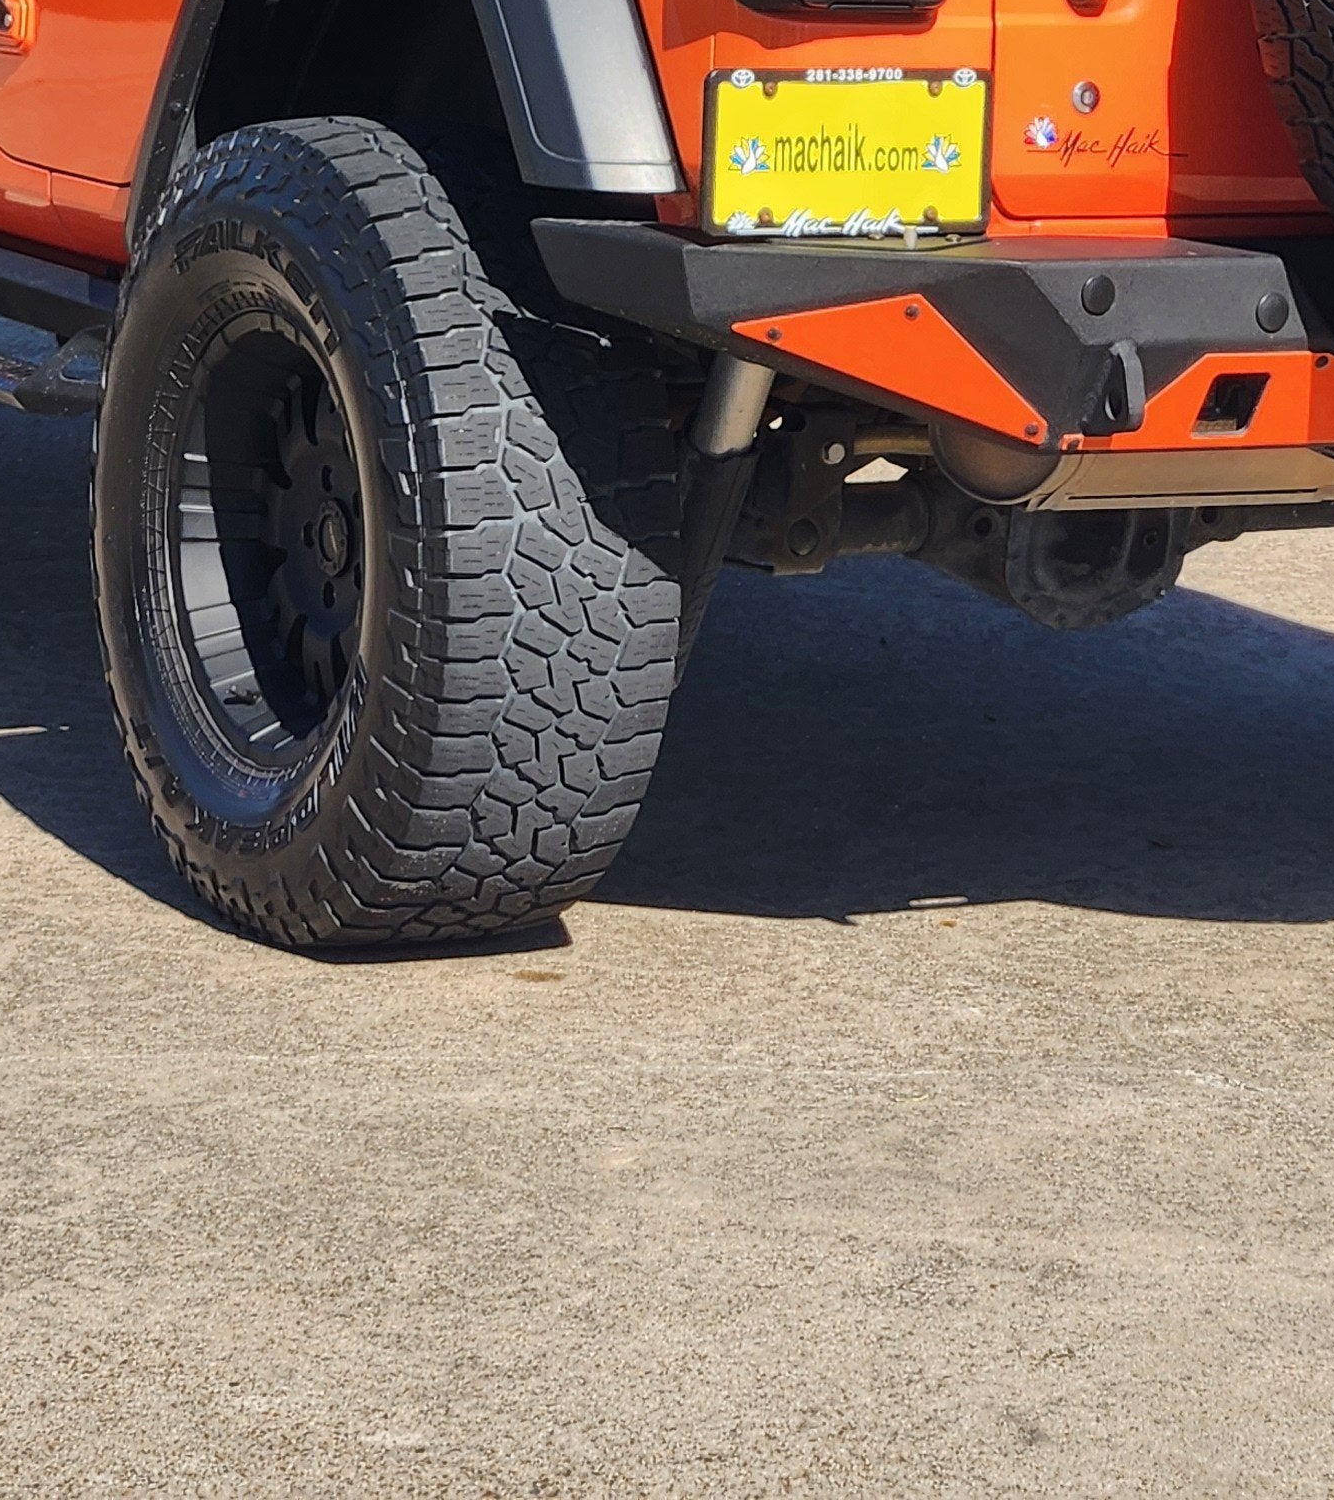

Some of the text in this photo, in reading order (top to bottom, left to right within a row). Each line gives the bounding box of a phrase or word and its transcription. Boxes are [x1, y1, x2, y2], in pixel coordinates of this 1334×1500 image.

[773, 123, 918, 173] machaik.com
[1058, 127, 1175, 168] Mac Haik
[780, 206, 910, 238] Mac Haik
[170, 218, 340, 357] FALKEN
